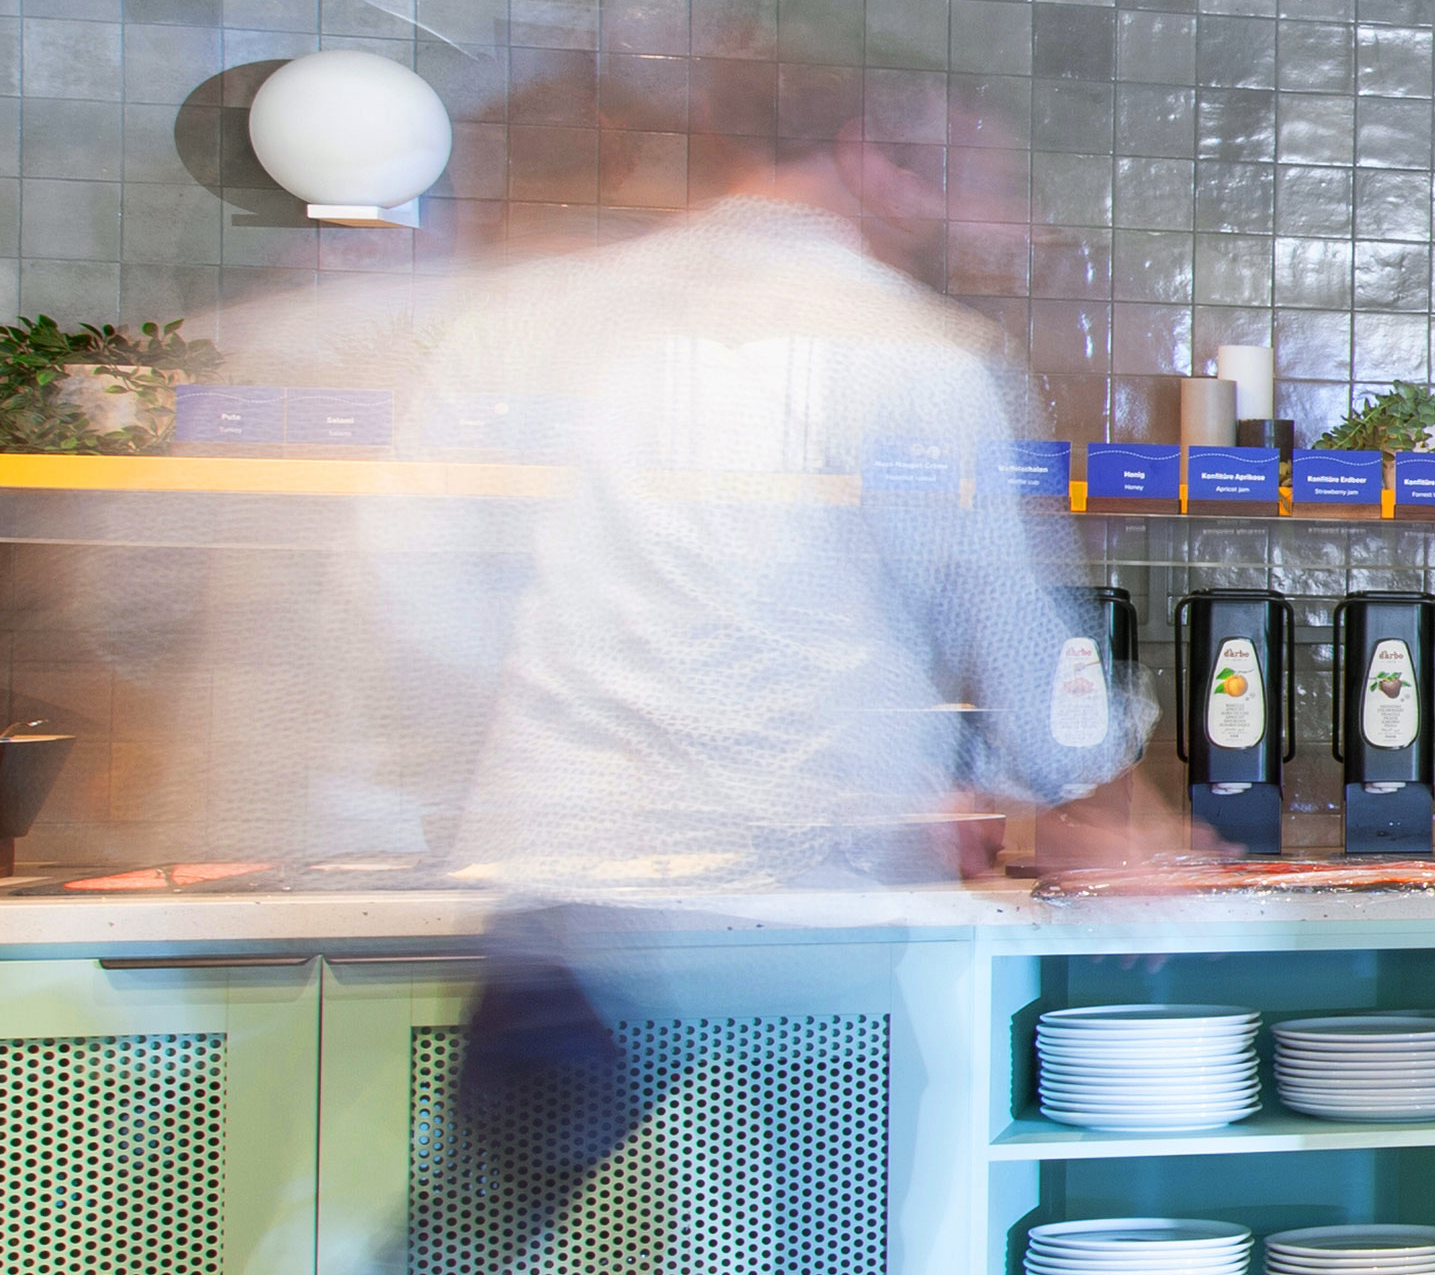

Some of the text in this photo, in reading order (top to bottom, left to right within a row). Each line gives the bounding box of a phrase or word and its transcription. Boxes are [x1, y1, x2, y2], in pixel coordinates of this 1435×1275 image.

[220, 413, 242, 421] Pute
[327, 416, 354, 424] Salami
[1123, 470, 1146, 480] Honig
[1201, 471, 1266, 482] Konfitüre Aprikose
[1307, 475, 1368, 484] Konfitüre Erdbeer
[1403, 478, 1435, 487] Konfitüre
[1124, 484, 1144, 492] Honey
[1216, 485, 1237, 493] Apricot
[1314, 487, 1346, 496] Strawberry
